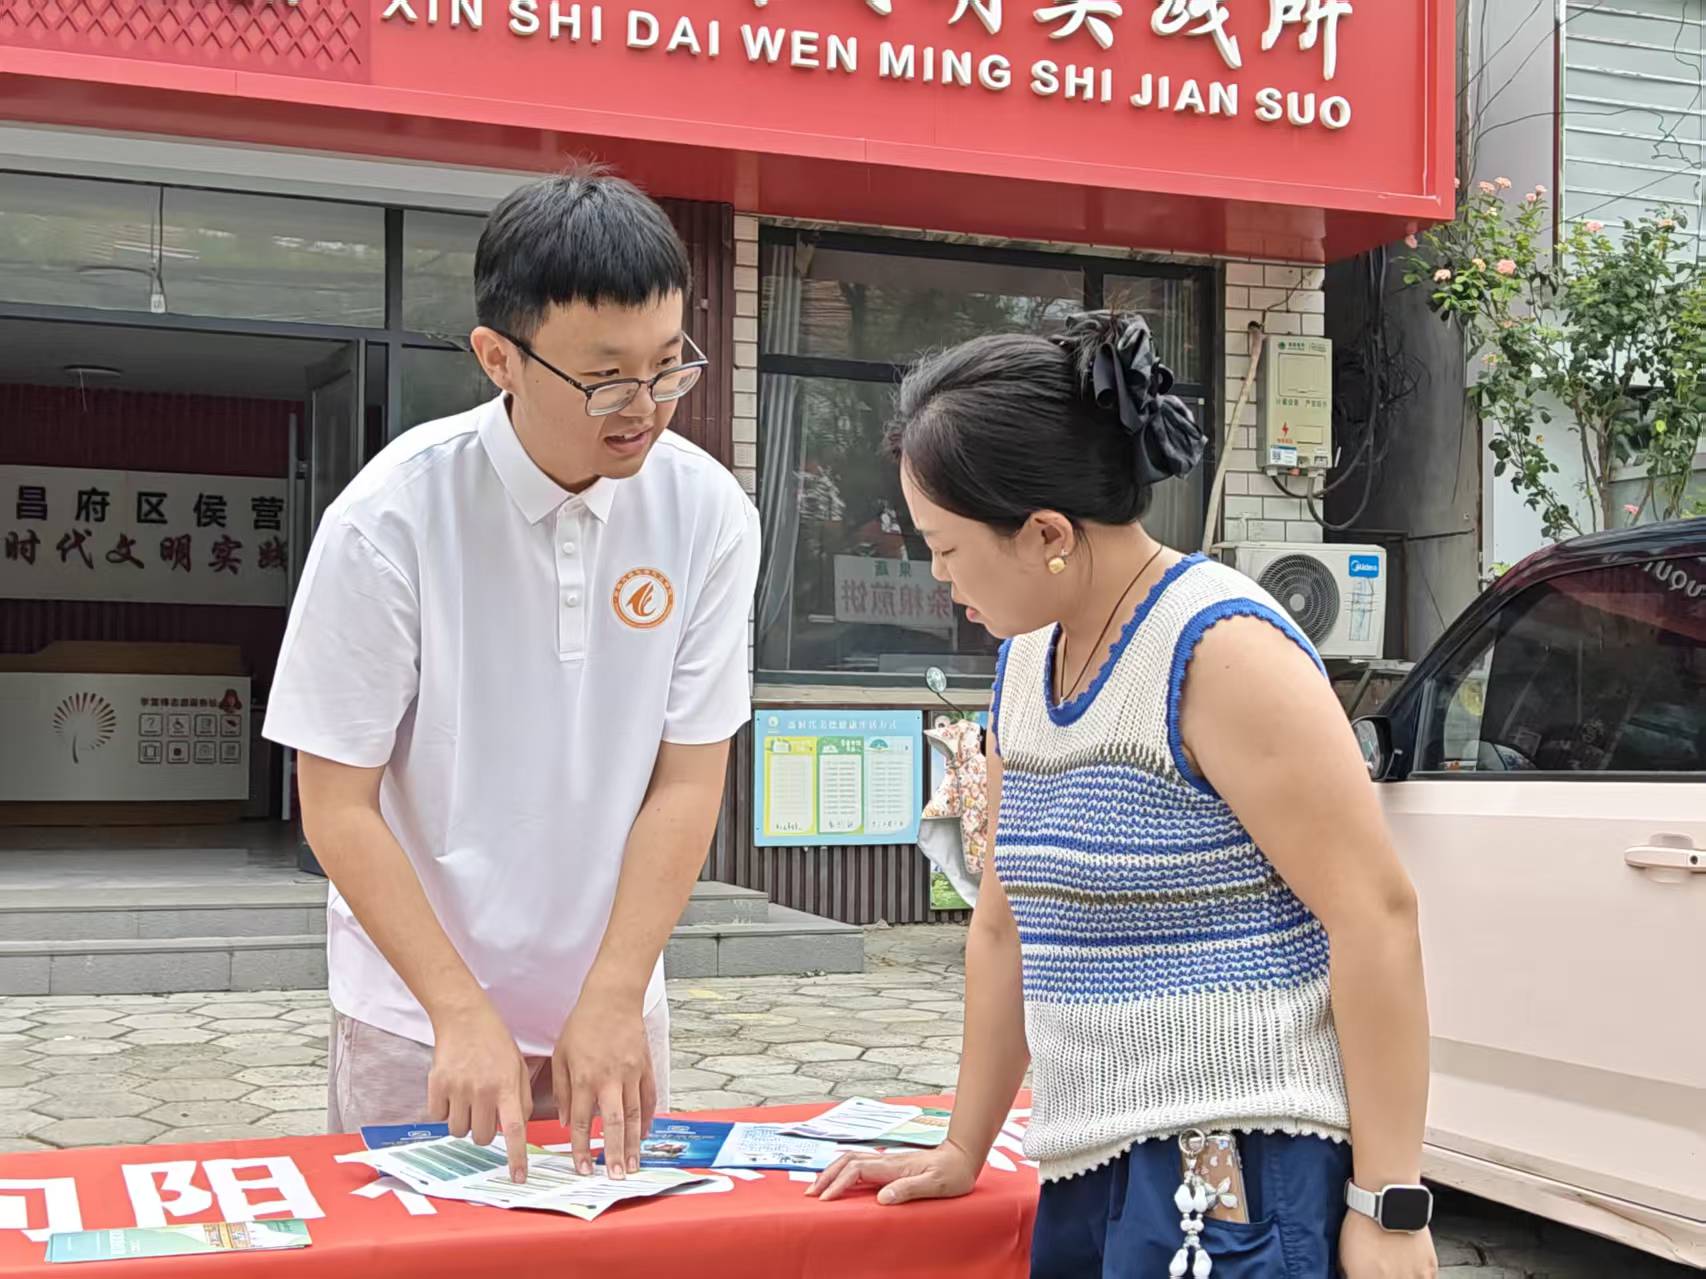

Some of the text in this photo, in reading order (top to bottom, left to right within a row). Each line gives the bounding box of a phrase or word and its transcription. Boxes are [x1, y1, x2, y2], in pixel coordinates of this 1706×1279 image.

[382, 0, 1352, 130] XIN SHI DAI WEN MING SHI JIAN SUO
[15, 485, 285, 532] 昌府区侯营
